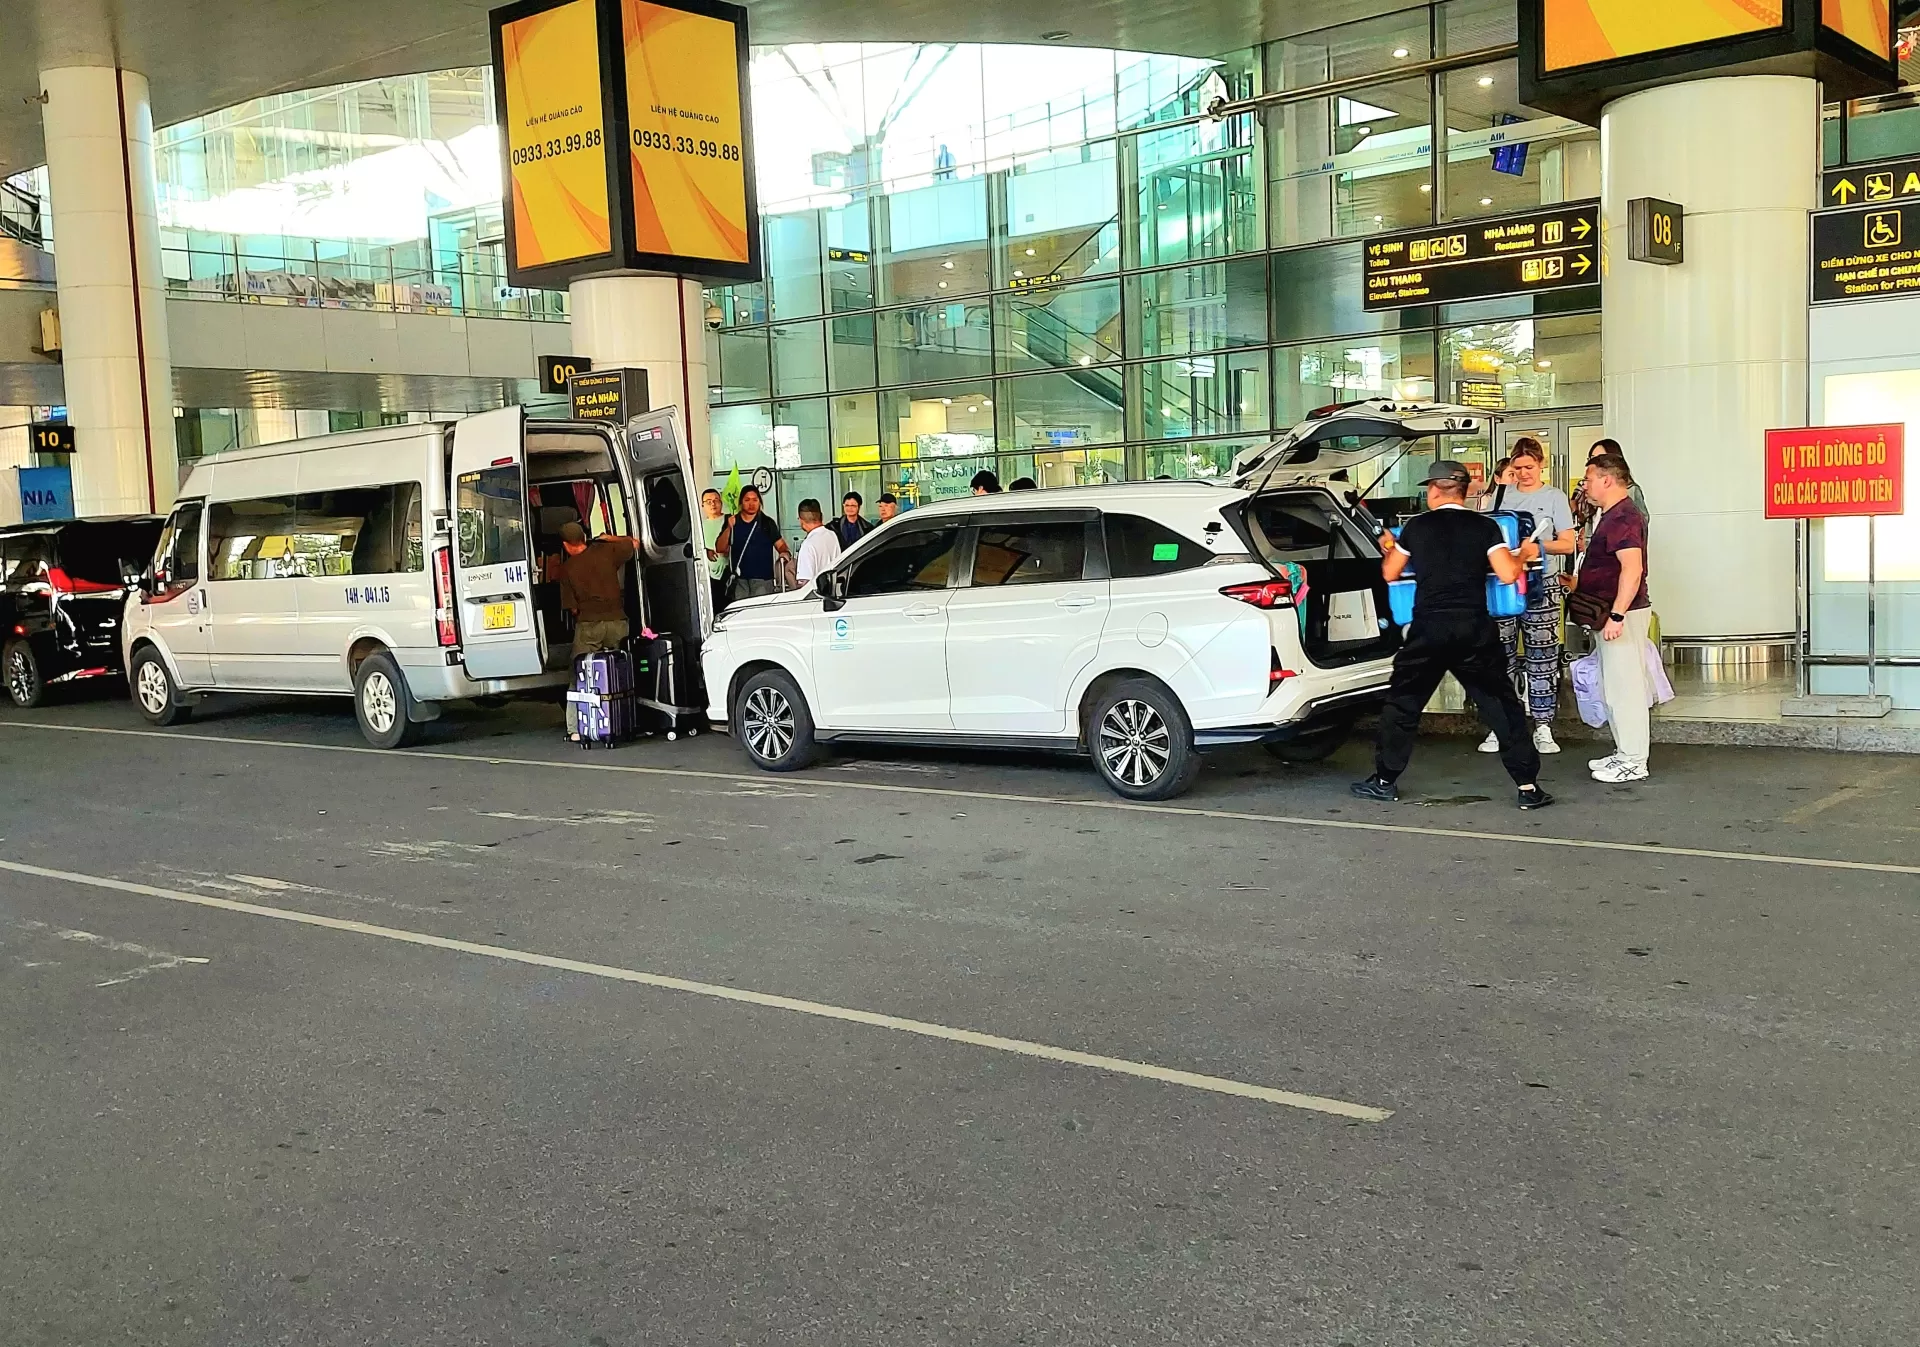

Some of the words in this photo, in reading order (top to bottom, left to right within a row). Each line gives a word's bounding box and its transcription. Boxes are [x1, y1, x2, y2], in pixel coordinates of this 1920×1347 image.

[650, 104, 667, 115] LIÊN
[668, 107, 677, 118] HỆ
[526, 117, 539, 127] LIÊN
[540, 113, 547, 123] HỆ
[513, 129, 601, 165] 0933.33.99.88
[633, 129, 739, 161] 0933.33.99.88
[1484, 226, 1505, 239] NHÀ
[1507, 224, 1535, 236] HÀNG
[1653, 213, 1672, 246] 08
[1368, 244, 1381, 256] VỆ
[1382, 242, 1404, 253] SINH
[1495, 238, 1535, 251] Restaurant
[1674, 242, 1681, 253] 1F
[1368, 258, 1390, 268] Toilets
[1821, 257, 1844, 269] ĐIỂM
[1845, 255, 1874, 266] DỪNG
[1875, 253, 1889, 263] XE
[1890, 251, 1912, 261] CHO
[1389, 273, 1422, 286] THANG
[1835, 272, 1856, 282] HẠN
[1856, 267, 1878, 280] CHẾ
[1398, 287, 1430, 297] Staircase
[1845, 283, 1879, 294] Station
[1880, 281, 1895, 290] for
[425, 291, 442, 300] NIA
[576, 395, 586, 406] XE
[586, 392, 598, 405] CÁ
[598, 391, 619, 403] NHÂN
[579, 407, 603, 418] Private
[603, 406, 617, 416] Car
[38, 431, 59, 447] 10
[1782, 446, 1796, 472] VỊ
[1799, 440, 1821, 468] TRÍ
[1824, 438, 1863, 467] DỪNG
[1866, 433, 1887, 465] ĐỖ
[1773, 474, 1795, 505] CỦA
[1797, 477, 1818, 505] CÁC
[1820, 476, 1849, 504] ĐOÀN
[1852, 477, 1867, 503] ƯU
[1869, 474, 1893, 502] TIÊN
[23, 490, 57, 506] NIA
[345, 587, 359, 605] 14H
[365, 586, 390, 603] 041.15
[492, 605, 506, 616] 14H
